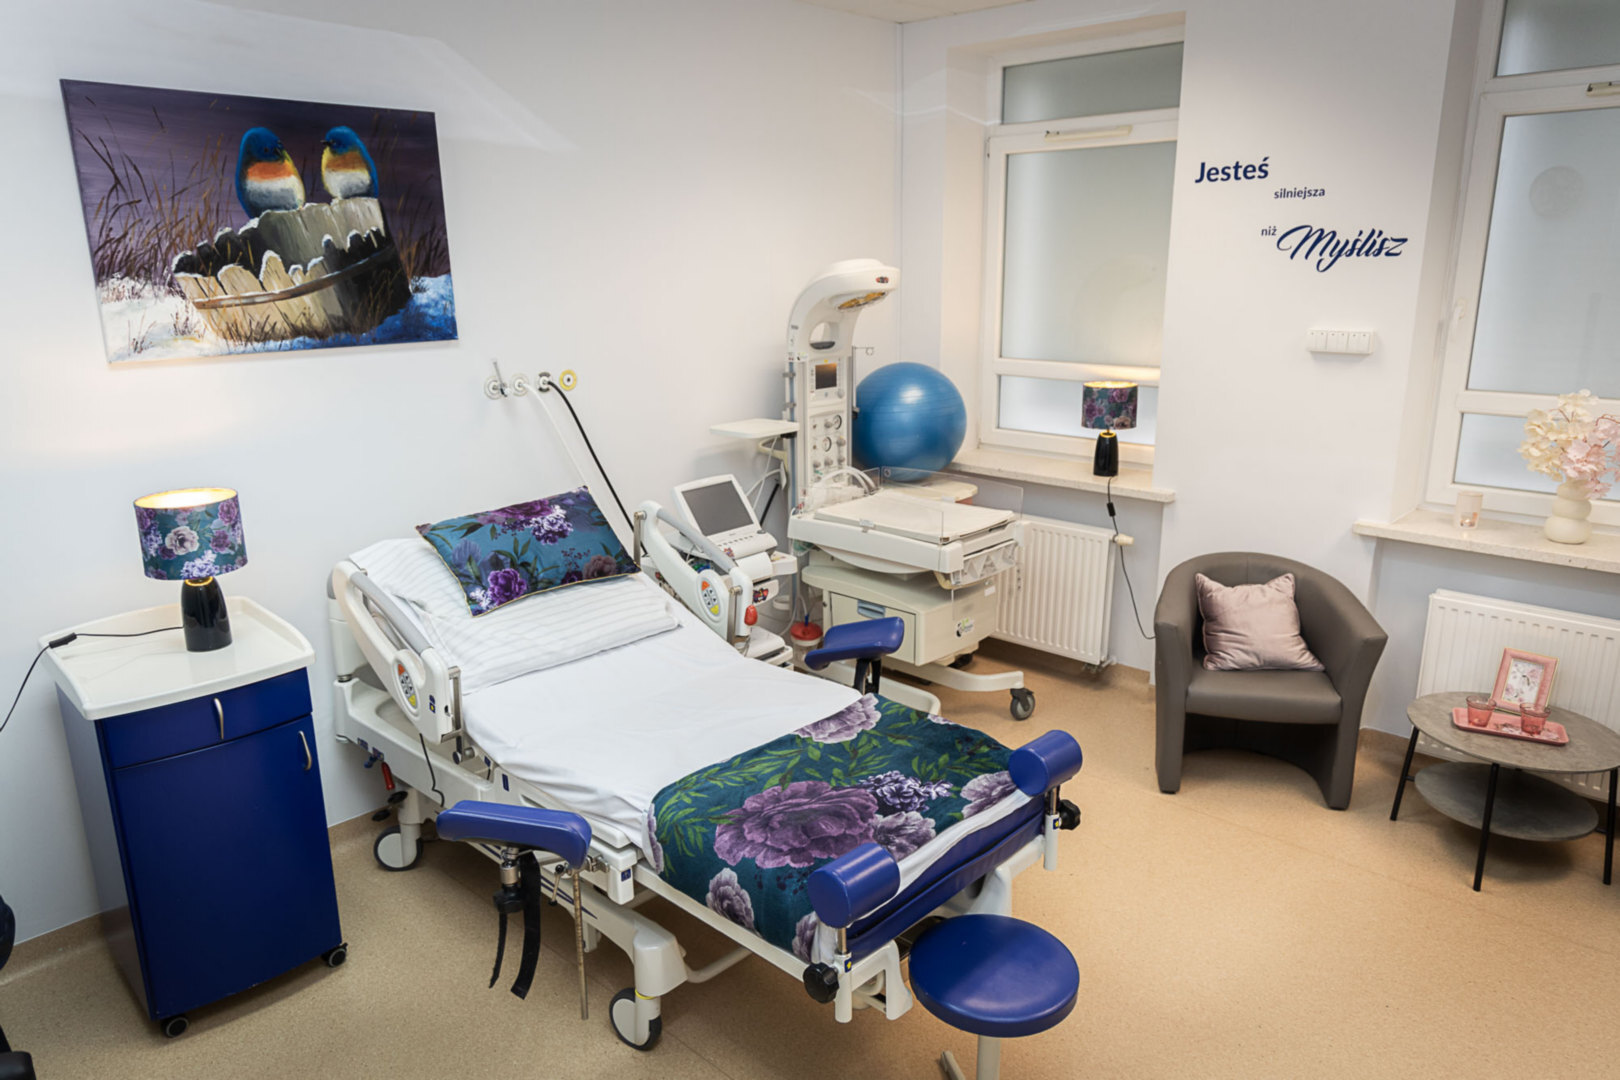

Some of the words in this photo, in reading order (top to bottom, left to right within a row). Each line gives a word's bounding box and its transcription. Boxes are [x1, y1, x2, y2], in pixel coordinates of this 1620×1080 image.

[1195, 156, 1269, 184] Jesteś
[1274, 186, 1326, 200] silniejsza
[1261, 226, 1277, 237] niż
[1276, 224, 1408, 273] Myślisz
